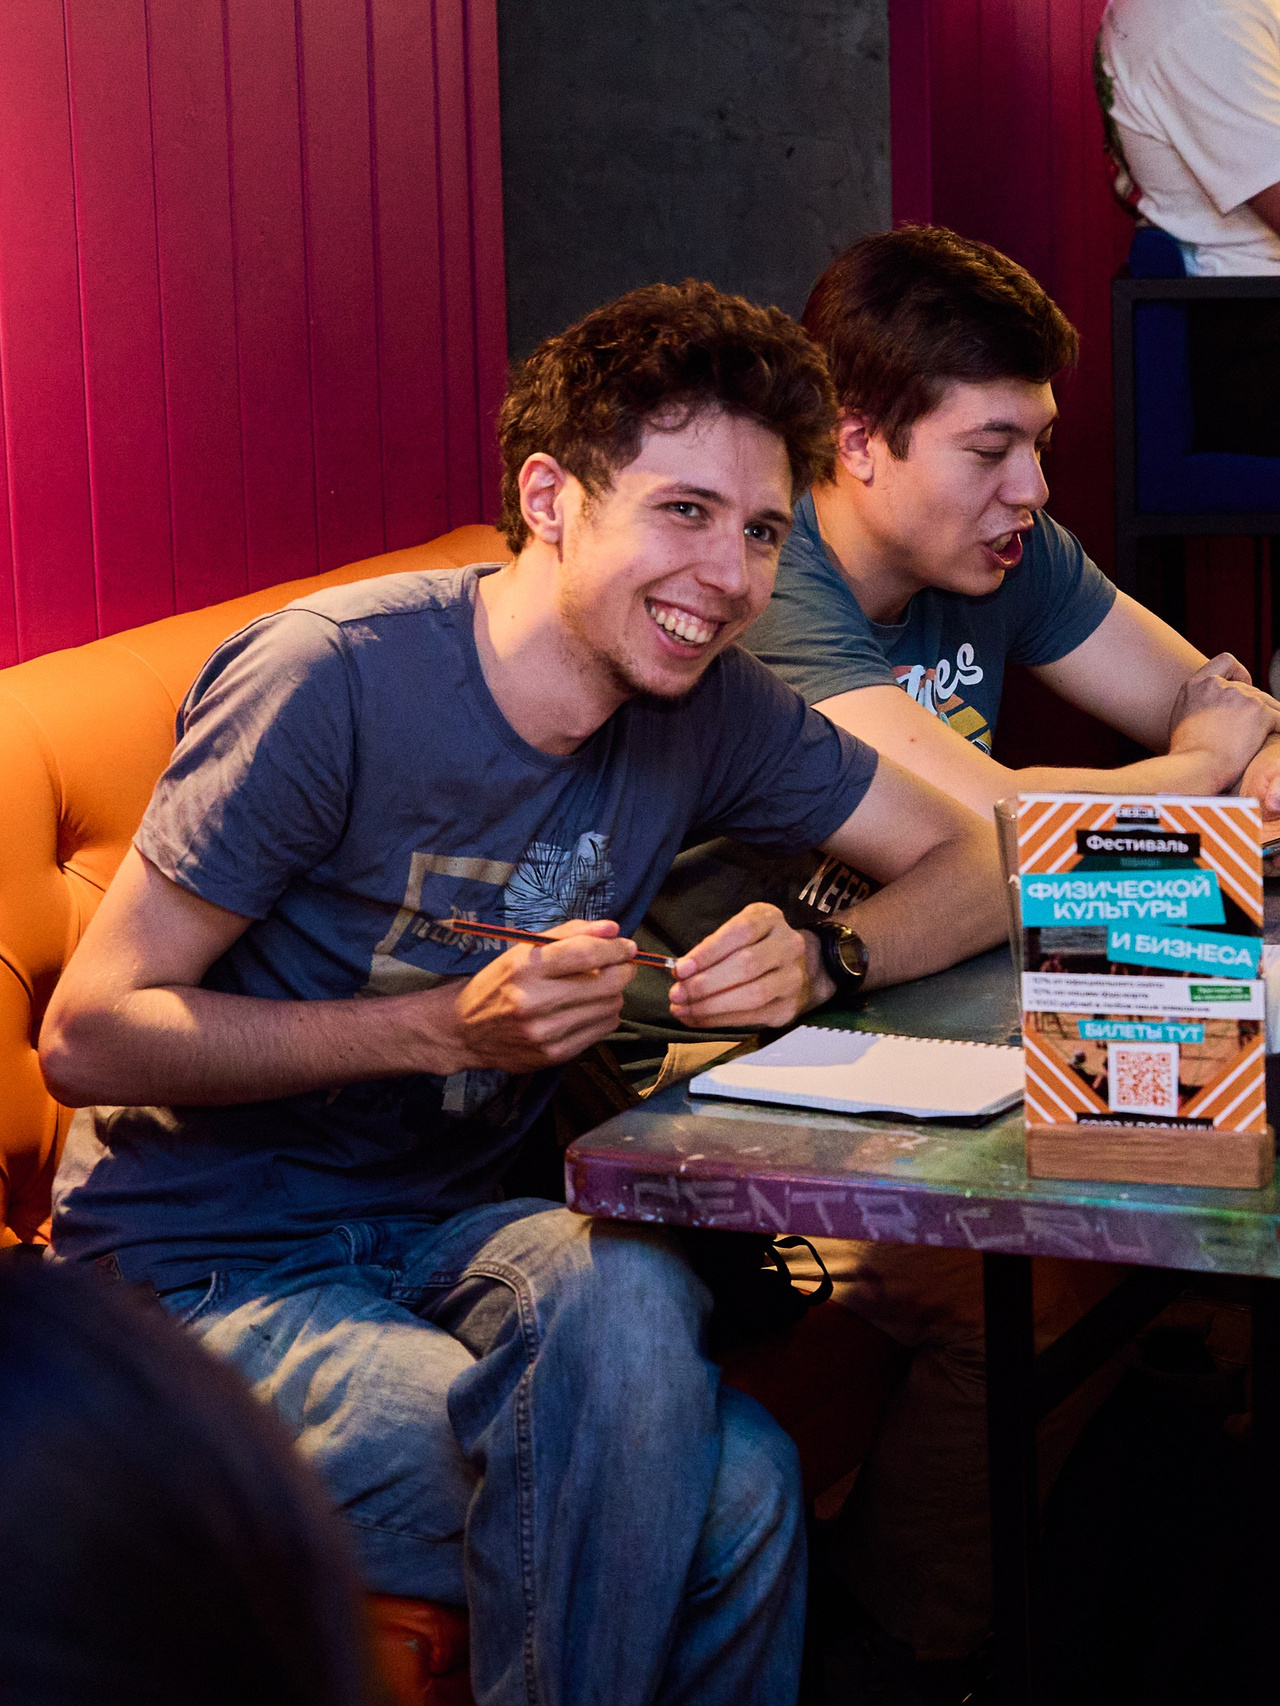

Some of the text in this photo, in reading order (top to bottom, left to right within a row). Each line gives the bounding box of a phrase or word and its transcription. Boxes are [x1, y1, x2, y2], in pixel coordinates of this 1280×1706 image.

[1086, 835, 1190, 854] Фестиваль
[1027, 874, 1211, 901] ФИЗИЧЕСКОЙ
[1053, 901, 1189, 920] КУЛЬТУРЫ
[1111, 932, 1252, 967] И БИЗНЕСА
[1084, 1023, 1201, 1042] БИЛЕТЫ ТУТ
